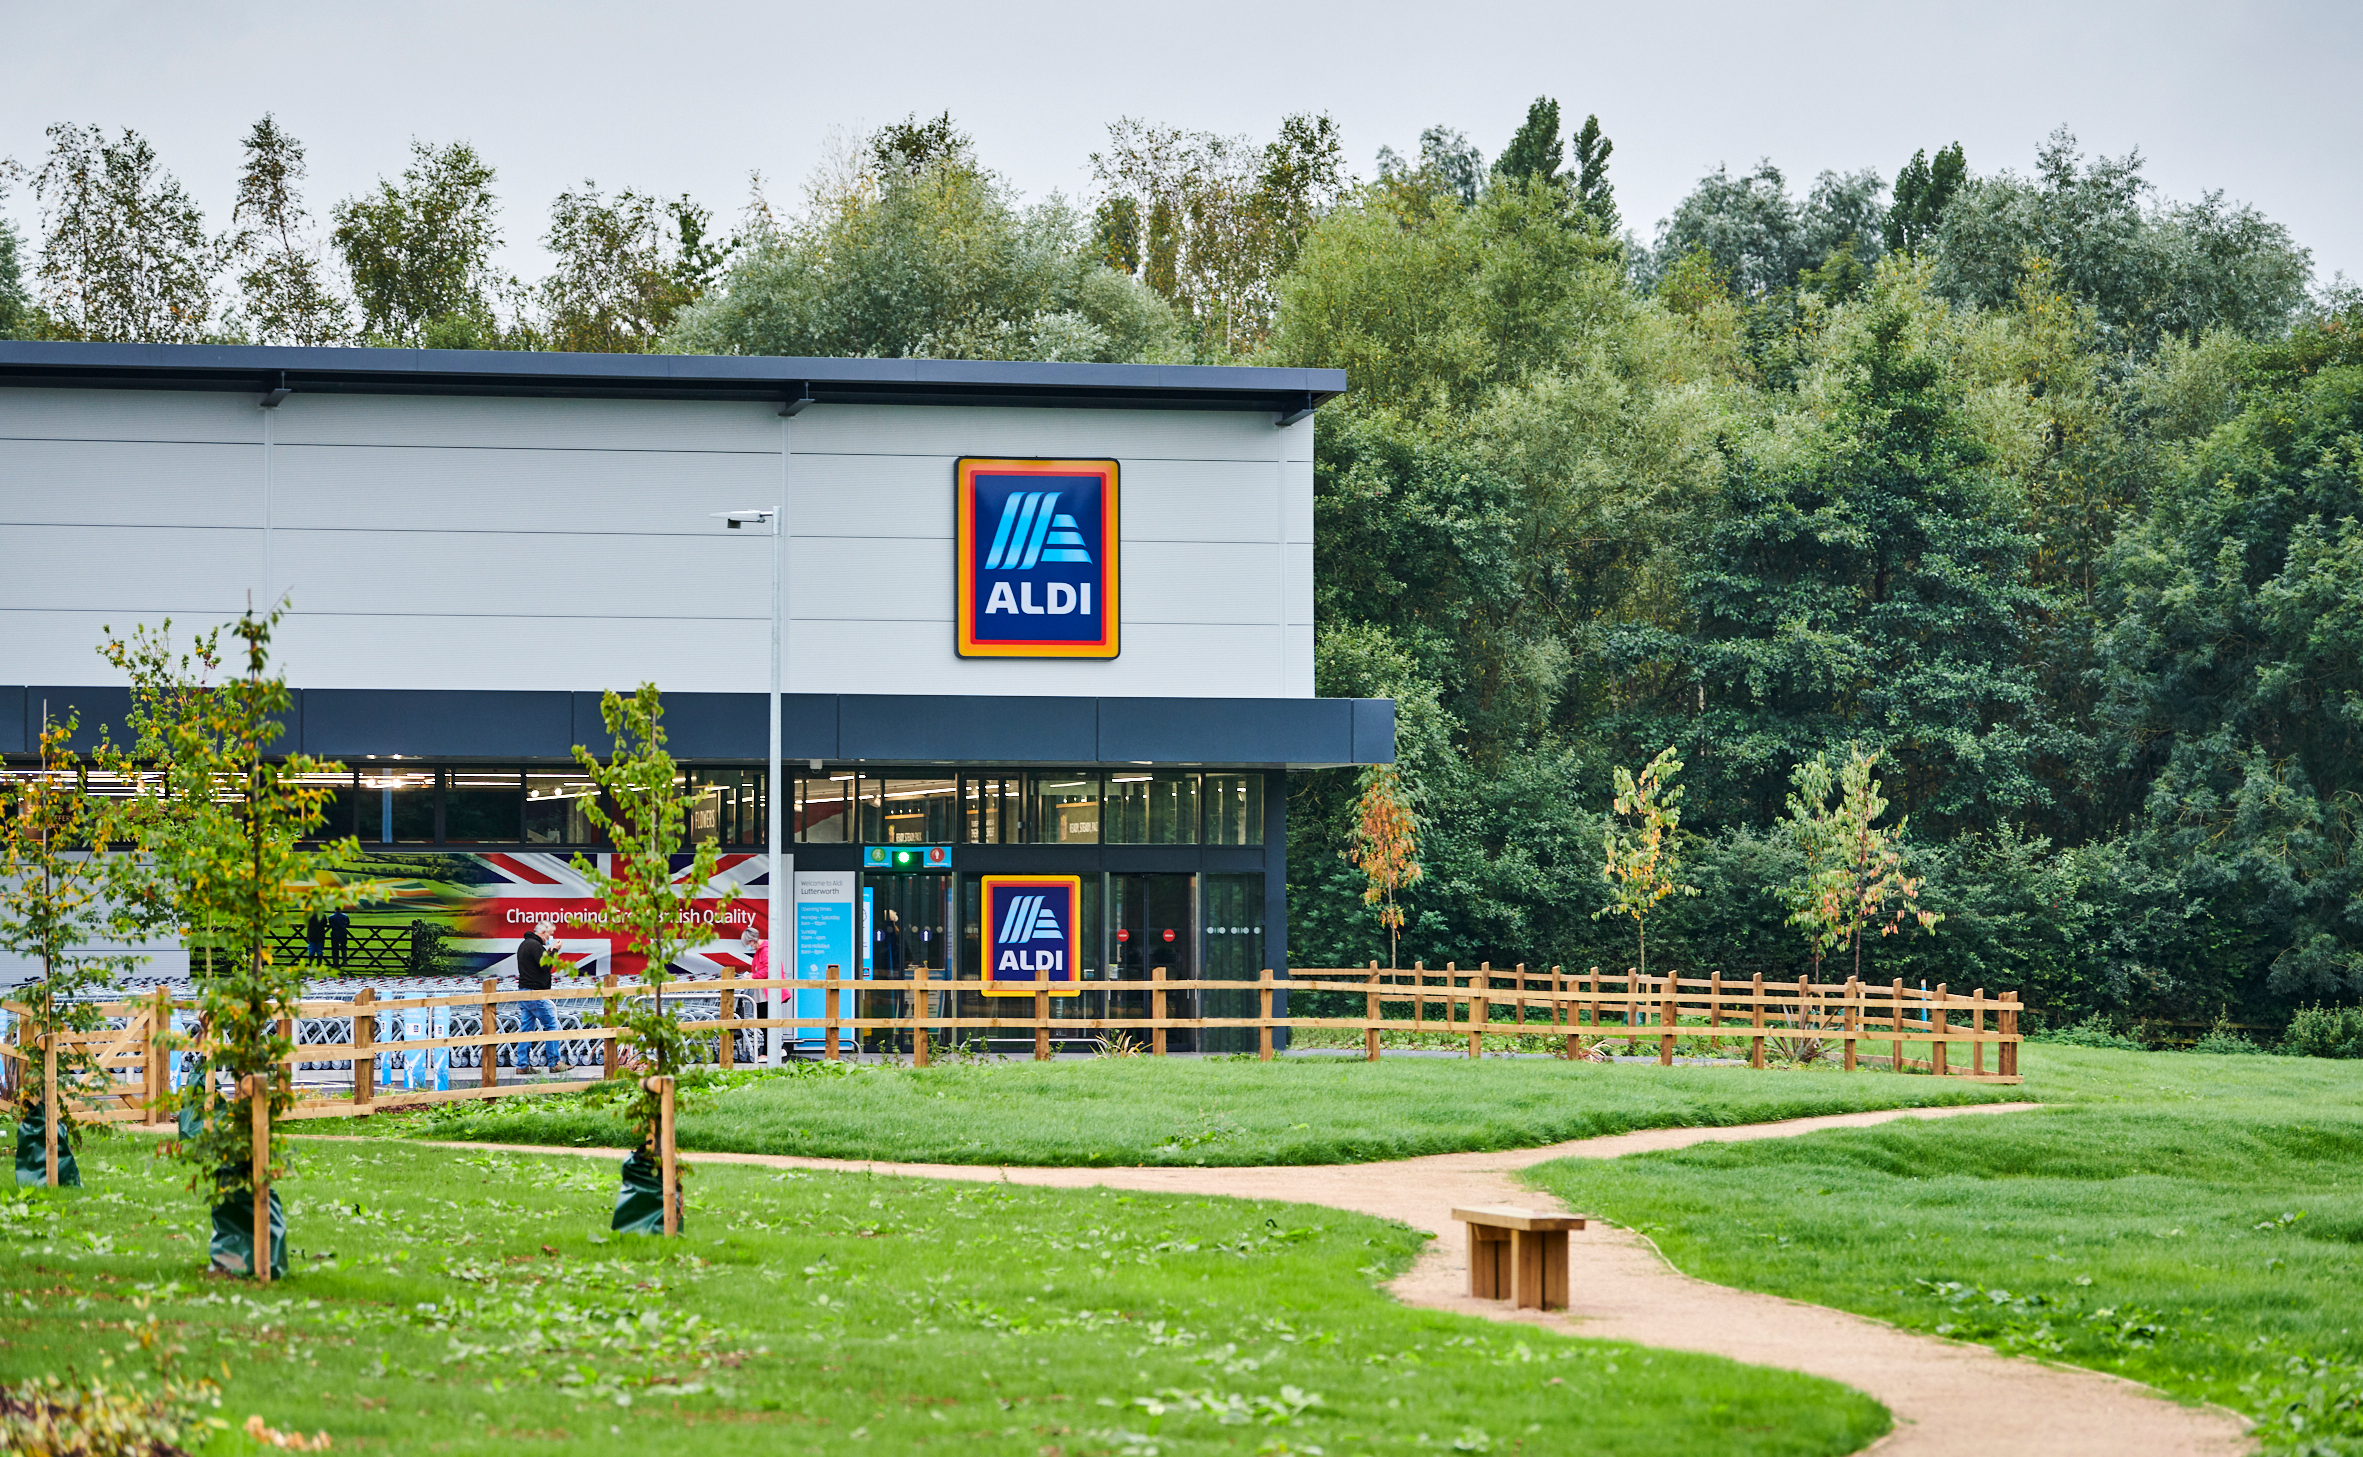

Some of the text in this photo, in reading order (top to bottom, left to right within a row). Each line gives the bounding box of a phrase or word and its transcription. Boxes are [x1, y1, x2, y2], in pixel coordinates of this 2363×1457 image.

[985, 582, 1091, 615] ALDI
[695, 809, 715, 830] FLOWERS
[506, 908, 608, 927] Championing
[703, 908, 756, 926] Quality
[998, 950, 1063, 971] ALDI
